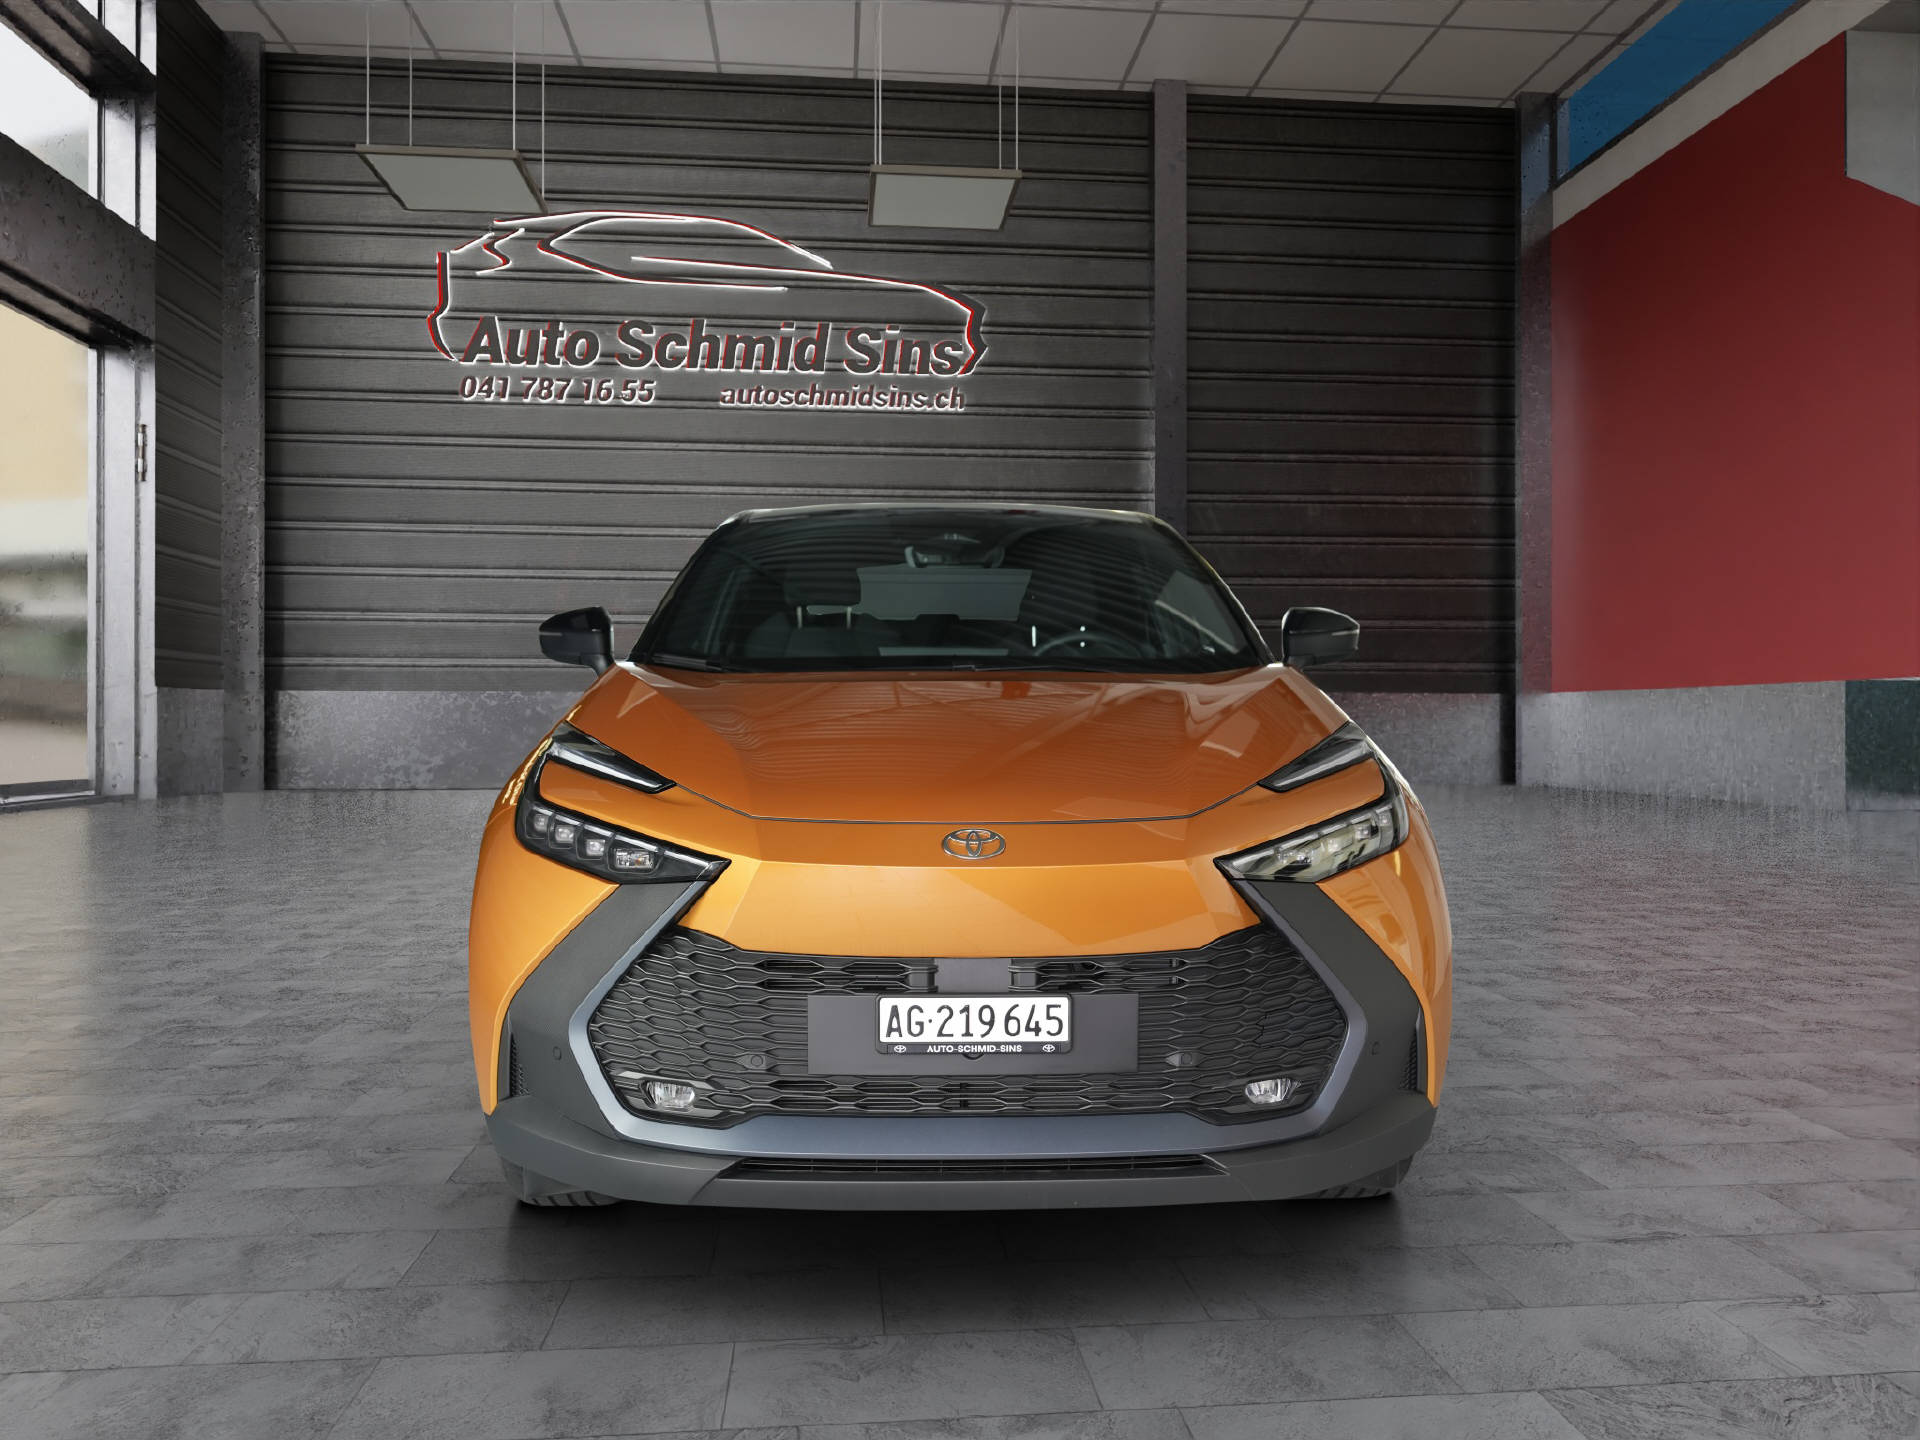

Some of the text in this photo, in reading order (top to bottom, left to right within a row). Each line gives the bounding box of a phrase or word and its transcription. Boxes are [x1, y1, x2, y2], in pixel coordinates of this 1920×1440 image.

[459, 315, 964, 376] Auto Schmid Sins
[460, 376, 657, 405] 041 787 16 55
[719, 383, 966, 411] autoschmidsins.ch
[926, 1044, 1023, 1053] AUTO-SCHMID-SINS
